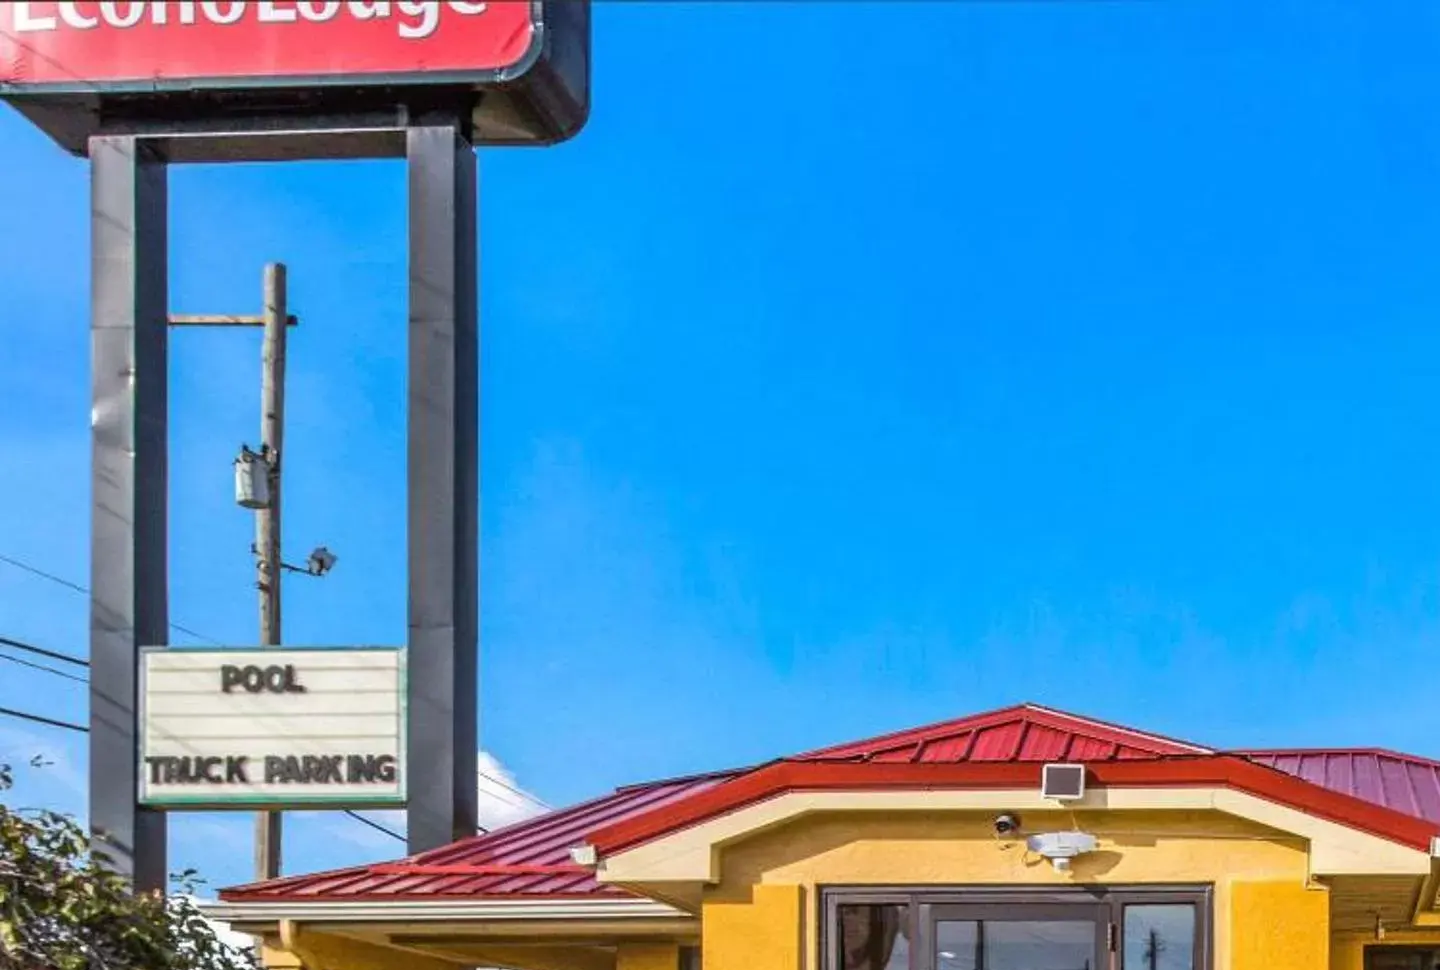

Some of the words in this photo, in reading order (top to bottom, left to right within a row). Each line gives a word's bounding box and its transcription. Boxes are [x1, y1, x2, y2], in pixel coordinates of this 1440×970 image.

[221, 664, 307, 693] POOL
[145, 756, 249, 784] TRUCK
[264, 754, 396, 784] PARKING
